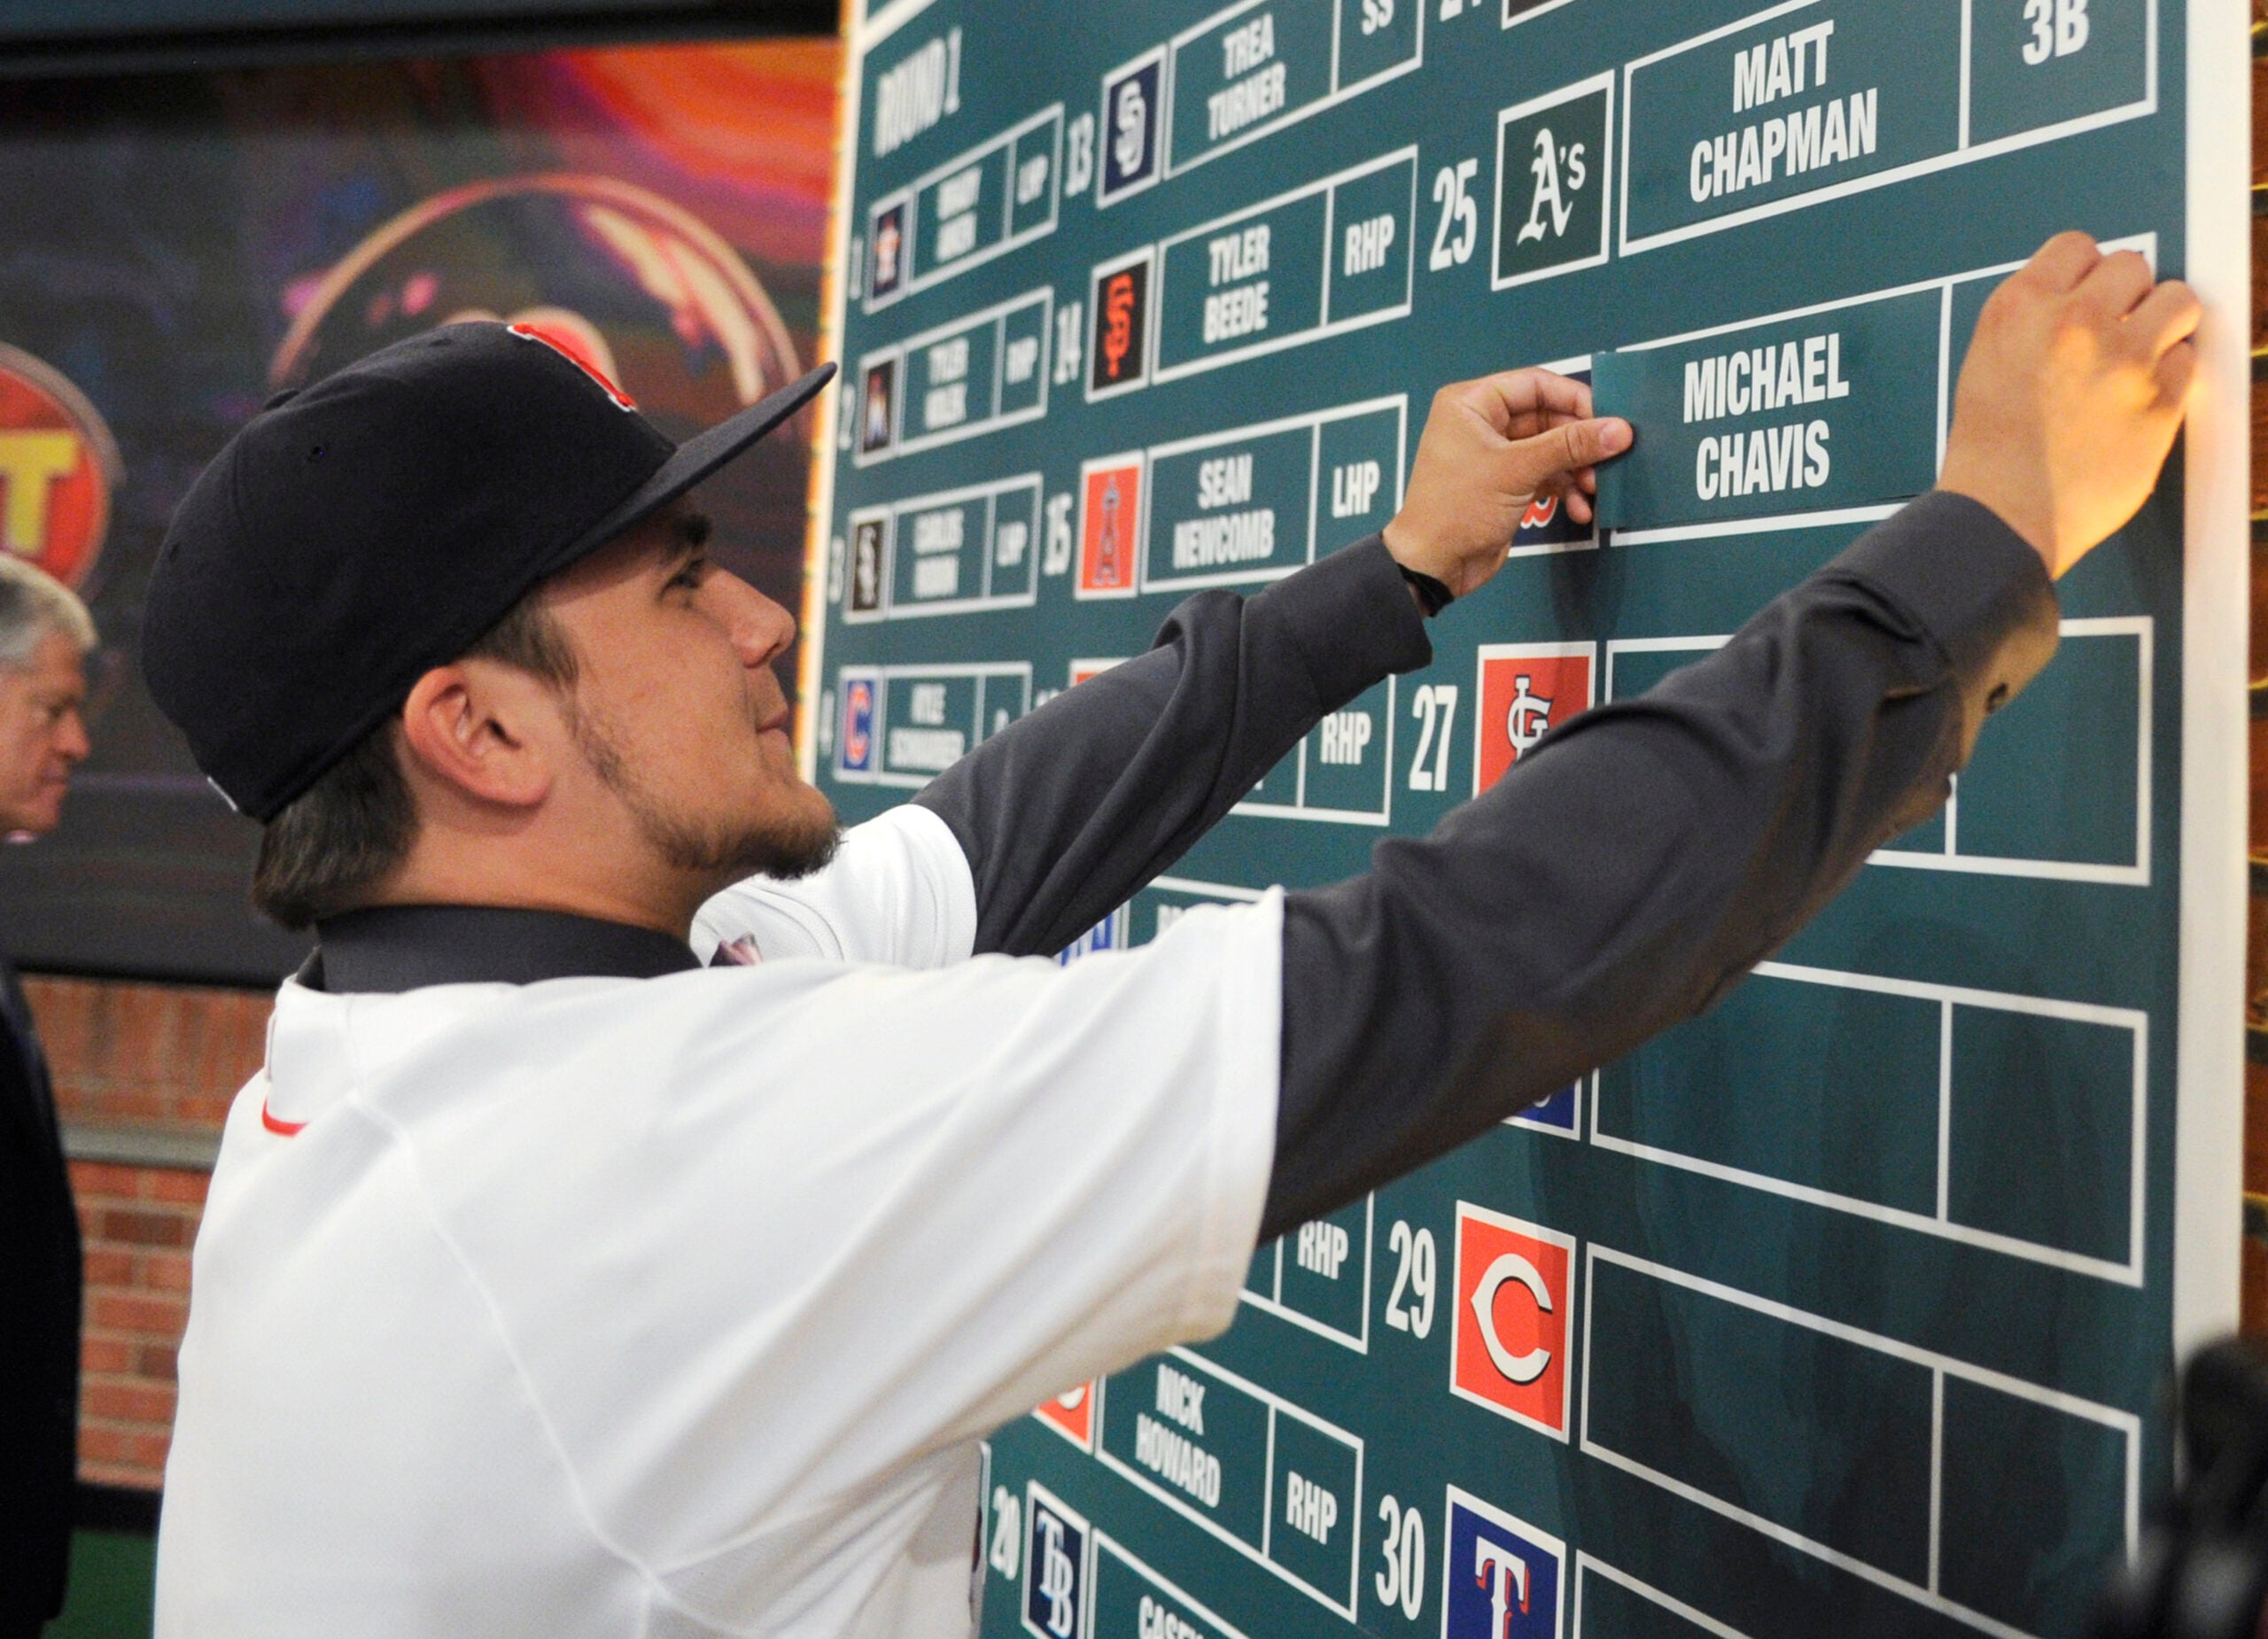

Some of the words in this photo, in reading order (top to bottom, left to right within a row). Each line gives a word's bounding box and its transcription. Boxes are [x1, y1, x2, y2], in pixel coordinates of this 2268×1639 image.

[1223, 12, 1274, 80] TREA
[1733, 19, 1834, 113] MATT
[2022, 0, 2091, 66] 3B
[1208, 62, 1285, 140] TURNER
[1065, 111, 1095, 198] 13
[1689, 87, 1877, 203] CHAPMAN
[1429, 158, 1478, 272] 25
[1516, 128, 1586, 246] A's
[1208, 223, 1271, 287] TYLER
[1343, 213, 1395, 276] RHP
[1203, 281, 1270, 344] BEEDE
[1683, 332, 1850, 423] MICHAEL
[1198, 453, 1253, 509] SEAN
[1332, 460, 1380, 518] LHP
[1696, 419, 1830, 501] CHAVIS
[1173, 508, 1275, 569] NEWCOMB
[1320, 711, 1372, 765] RHP
[1409, 685, 1457, 791] 27
[1297, 1220, 1348, 1280] RHP
[1386, 1220, 1436, 1340] 29
[1470, 1253, 1553, 1387] C
[1156, 1363, 1206, 1436] NICK
[1135, 1412, 1222, 1509] HOWARD
[1286, 1470, 1338, 1545] RHP
[1374, 1495, 1425, 1620] 30
